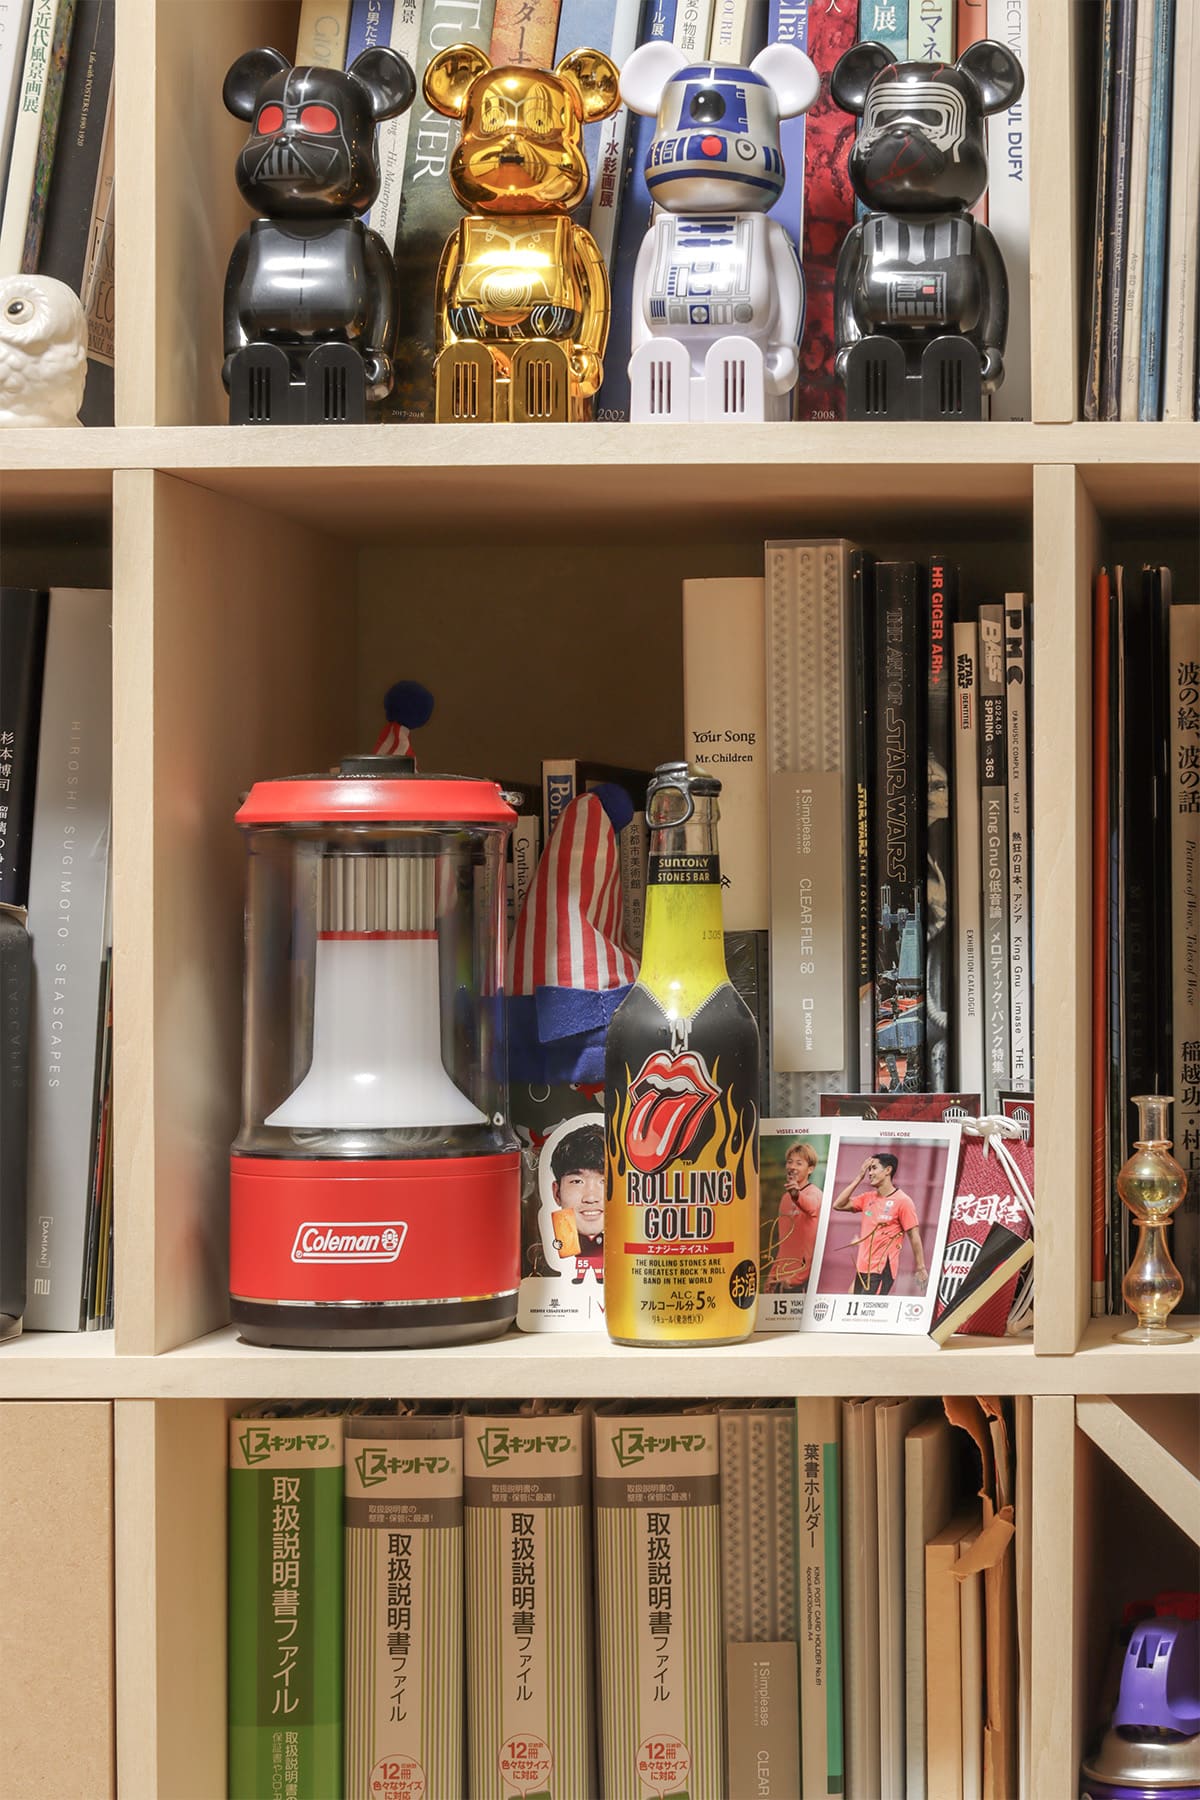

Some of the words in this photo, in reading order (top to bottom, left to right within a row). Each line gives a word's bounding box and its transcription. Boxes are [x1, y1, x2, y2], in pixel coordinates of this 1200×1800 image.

[82, 79, 94, 114] POSTERS
[1008, 132, 1024, 181] DUFY
[597, 408, 625, 421] 2002
[812, 410, 836, 420] 2008
[931, 566, 944, 589] HR
[931, 592, 944, 640] GIGER
[980, 619, 1003, 685] BASS
[957, 654, 966, 688] WARS
[964, 654, 973, 688] STAR
[962, 692, 970, 730] IDENTITIES
[984, 699, 994, 742] SPRING
[692, 730, 723, 744] Your
[724, 730, 756, 745] Song
[886, 707, 906, 796] STAR
[1177, 661, 1200, 814] 波の絵、波の話
[64, 721, 81, 811] HIROSHI
[985, 757, 994, 779] 363
[1011, 746, 1020, 780] COMPLEX
[986, 800, 1000, 834] King
[886, 798, 907, 882] WARS
[516, 838, 529, 888] Cynthia
[629, 824, 641, 889] 京都市美術館
[1185, 839, 1197, 884] Pictures
[657, 872, 691, 882] STONES
[693, 872, 711, 881] BAR
[800, 879, 813, 931] CLEAR
[860, 884, 868, 919] FORCE
[800, 932, 813, 956] FILE
[860, 925, 868, 976] AWAKENS
[965, 930, 974, 971] EXHIBITION
[1012, 936, 1023, 961] King
[1185, 934, 1197, 963] Tales
[800, 961, 815, 975] 60
[1013, 965, 1023, 987] Gnu
[967, 973, 976, 1017] CATALOGUE
[1184, 978, 1196, 1007] Wave
[48, 962, 66, 1088] SEASCAPES
[804, 1012, 813, 1034] KING
[1014, 1002, 1024, 1034] imase
[1015, 1048, 1024, 1069] THE
[627, 1169, 735, 1206] ROLLING
[644, 1206, 715, 1242] GOLD
[40, 1220, 49, 1264] DAMIANI
[302, 1227, 379, 1253] Coleman
[647, 1244, 709, 1254] エナジーテイスト
[577, 1259, 589, 1268] 55
[636, 1259, 647, 1267] THE
[649, 1259, 678, 1267] ROLLING
[644, 1268, 678, 1276] GREATEST
[643, 1277, 661, 1285] BAND
[663, 1277, 671, 1285] IN
[673, 1277, 686, 1285] THE
[688, 1277, 713, 1285] WORLD
[731, 1273, 756, 1298] お酒
[640, 1300, 695, 1311] アルコール分
[773, 1300, 788, 1315] 15
[846, 1301, 859, 1316] 11
[255, 1432, 330, 1452] スキットマン
[493, 1432, 572, 1453] スキットマン
[628, 1432, 706, 1453] スキットマン
[372, 1454, 451, 1475] スキットマン
[803, 1444, 821, 1548] 葉書ホルダー
[271, 1476, 301, 1715] 取扱説明書ファイル
[511, 1512, 536, 1702] 取扱説明書ファイル
[647, 1512, 673, 1702] 取扱説明書ファイル
[387, 1533, 412, 1722] 取扱説明書ファイル
[501, 1759, 550, 1771] 色々なサイズ
[512, 1770, 539, 1781] に対応
[638, 1759, 688, 1771] 色々なサイズ
[650, 1770, 677, 1781] に対応
[756, 1750, 770, 1797] CLEAR
[373, 1781, 423, 1791] 色々なサイズ
